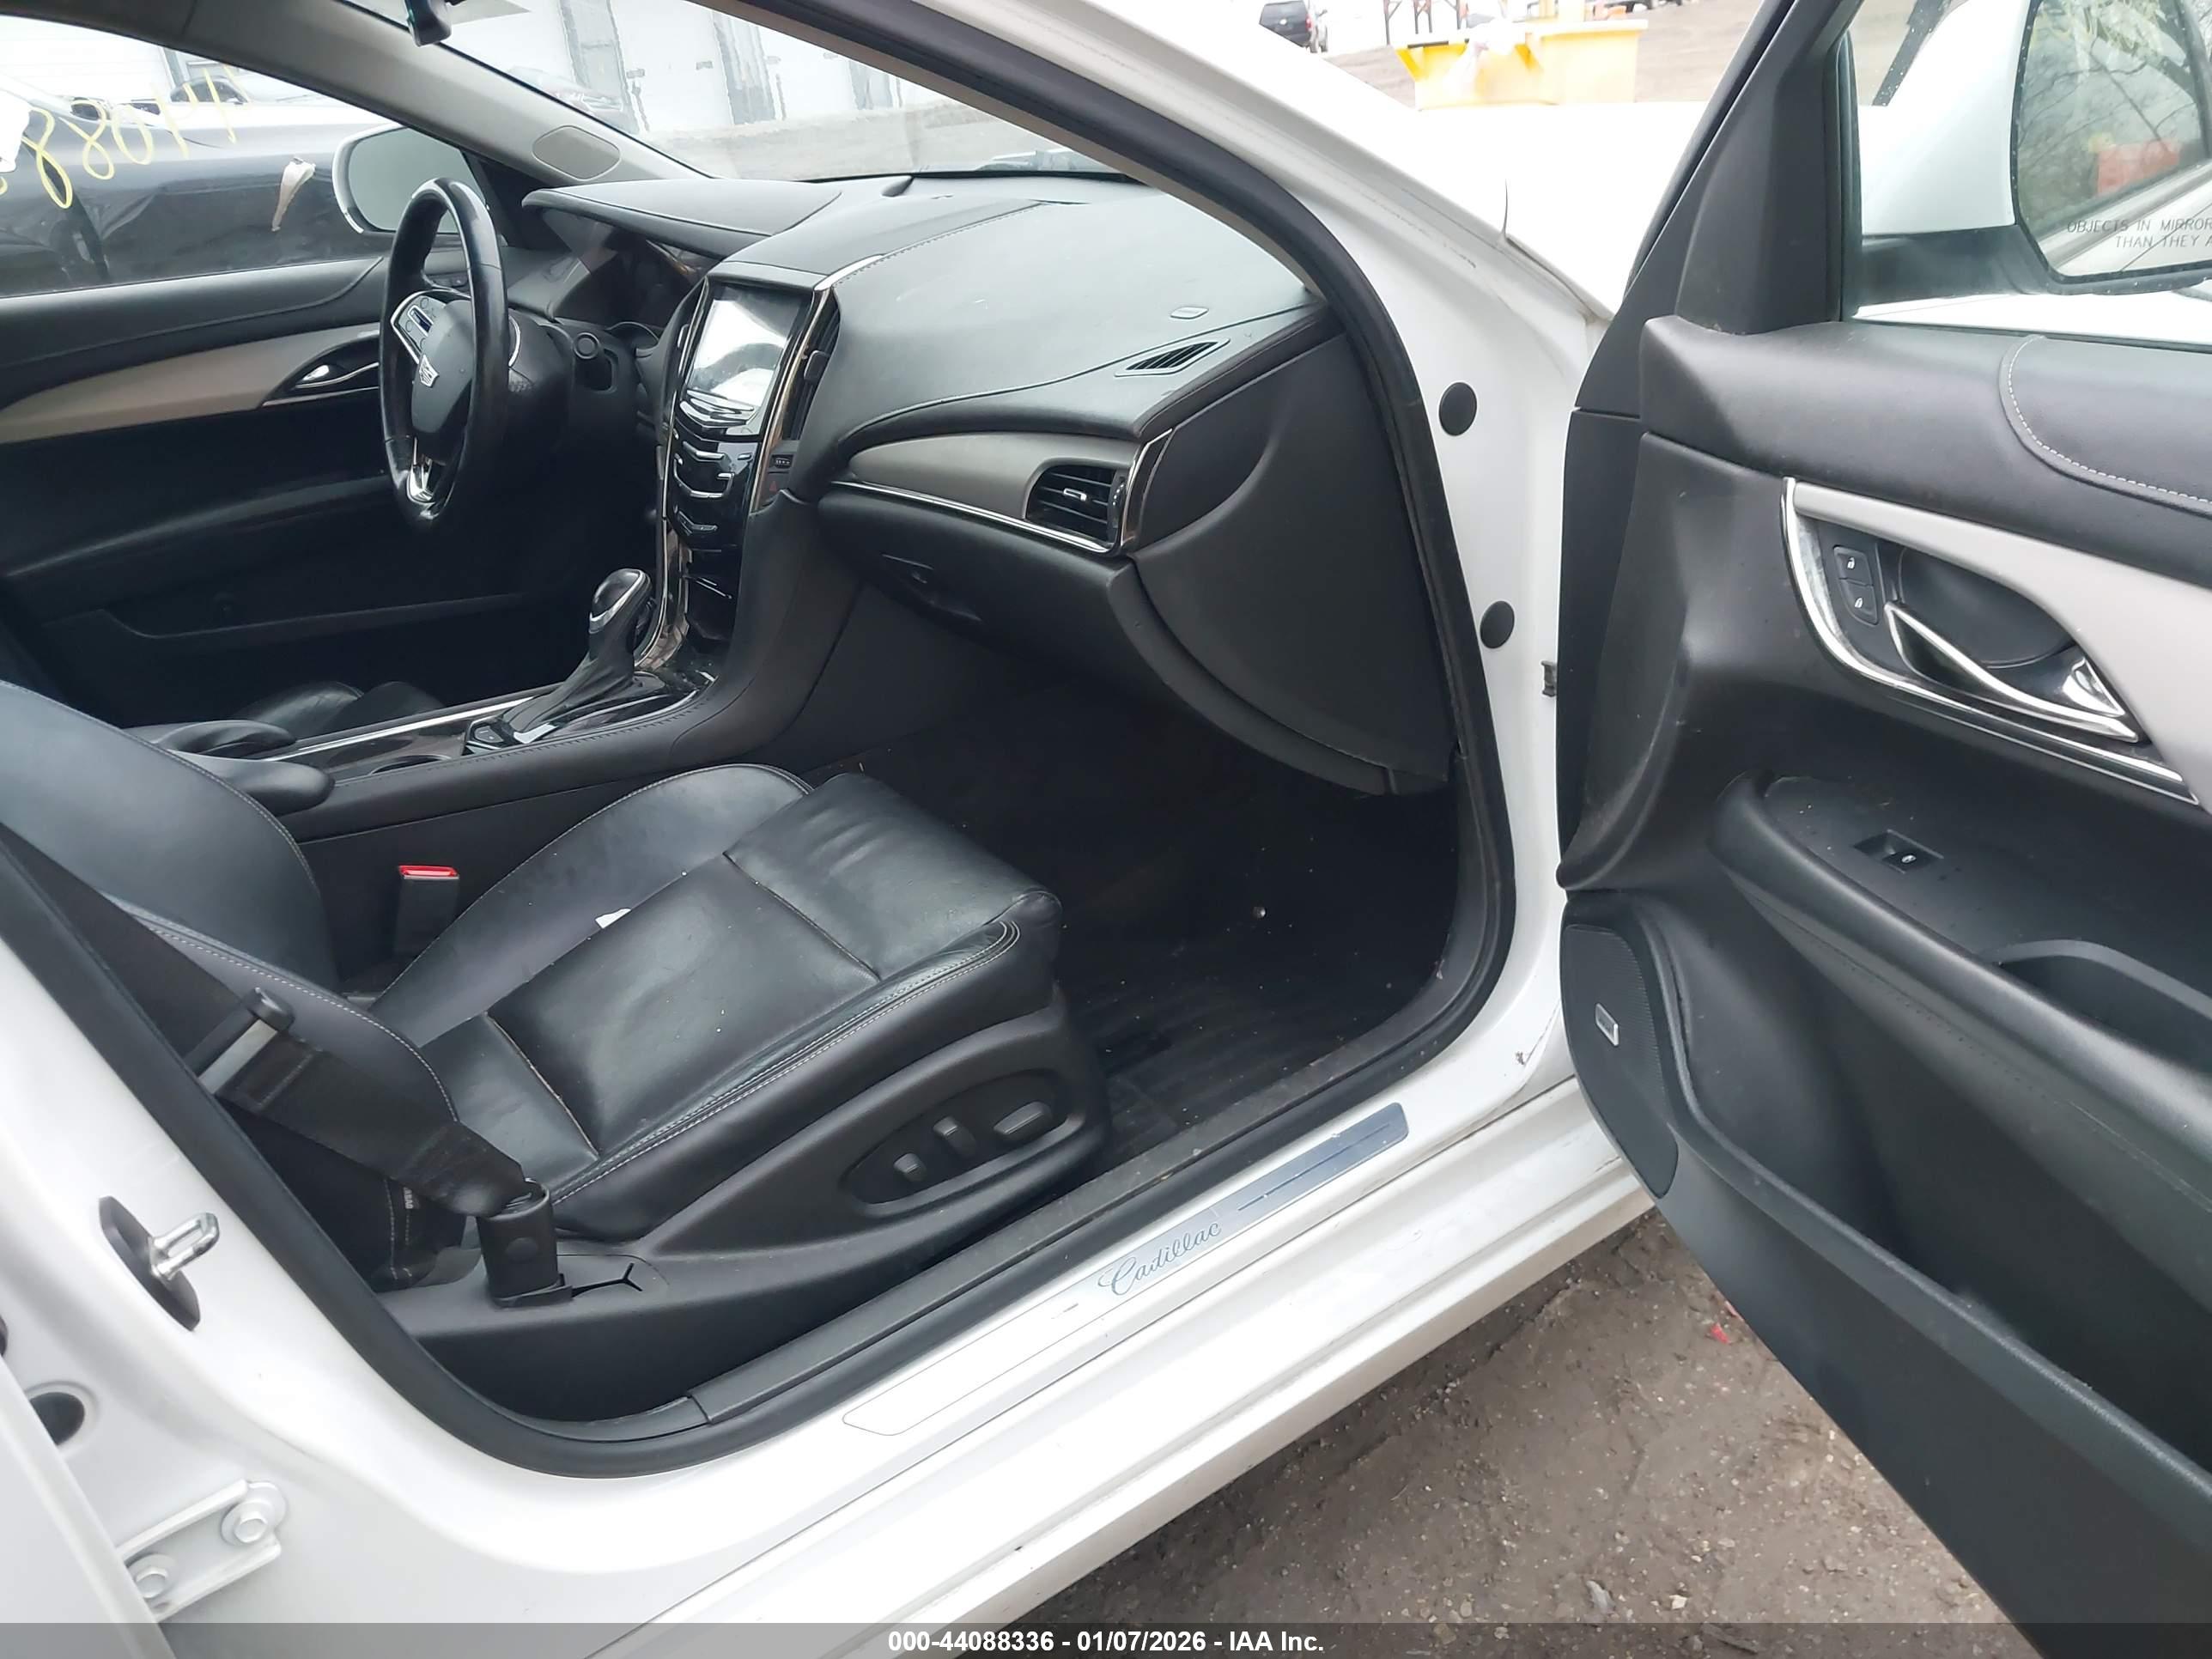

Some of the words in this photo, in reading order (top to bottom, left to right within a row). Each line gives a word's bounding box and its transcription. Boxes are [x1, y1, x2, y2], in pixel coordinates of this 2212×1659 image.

[2067, 219, 2130, 233] OBJECTS
[2136, 219, 2152, 232] IN
[2116, 235, 2154, 248] THAN
[2162, 235, 2200, 248] THEY
[1097, 1222, 1222, 1296] Cadillac
